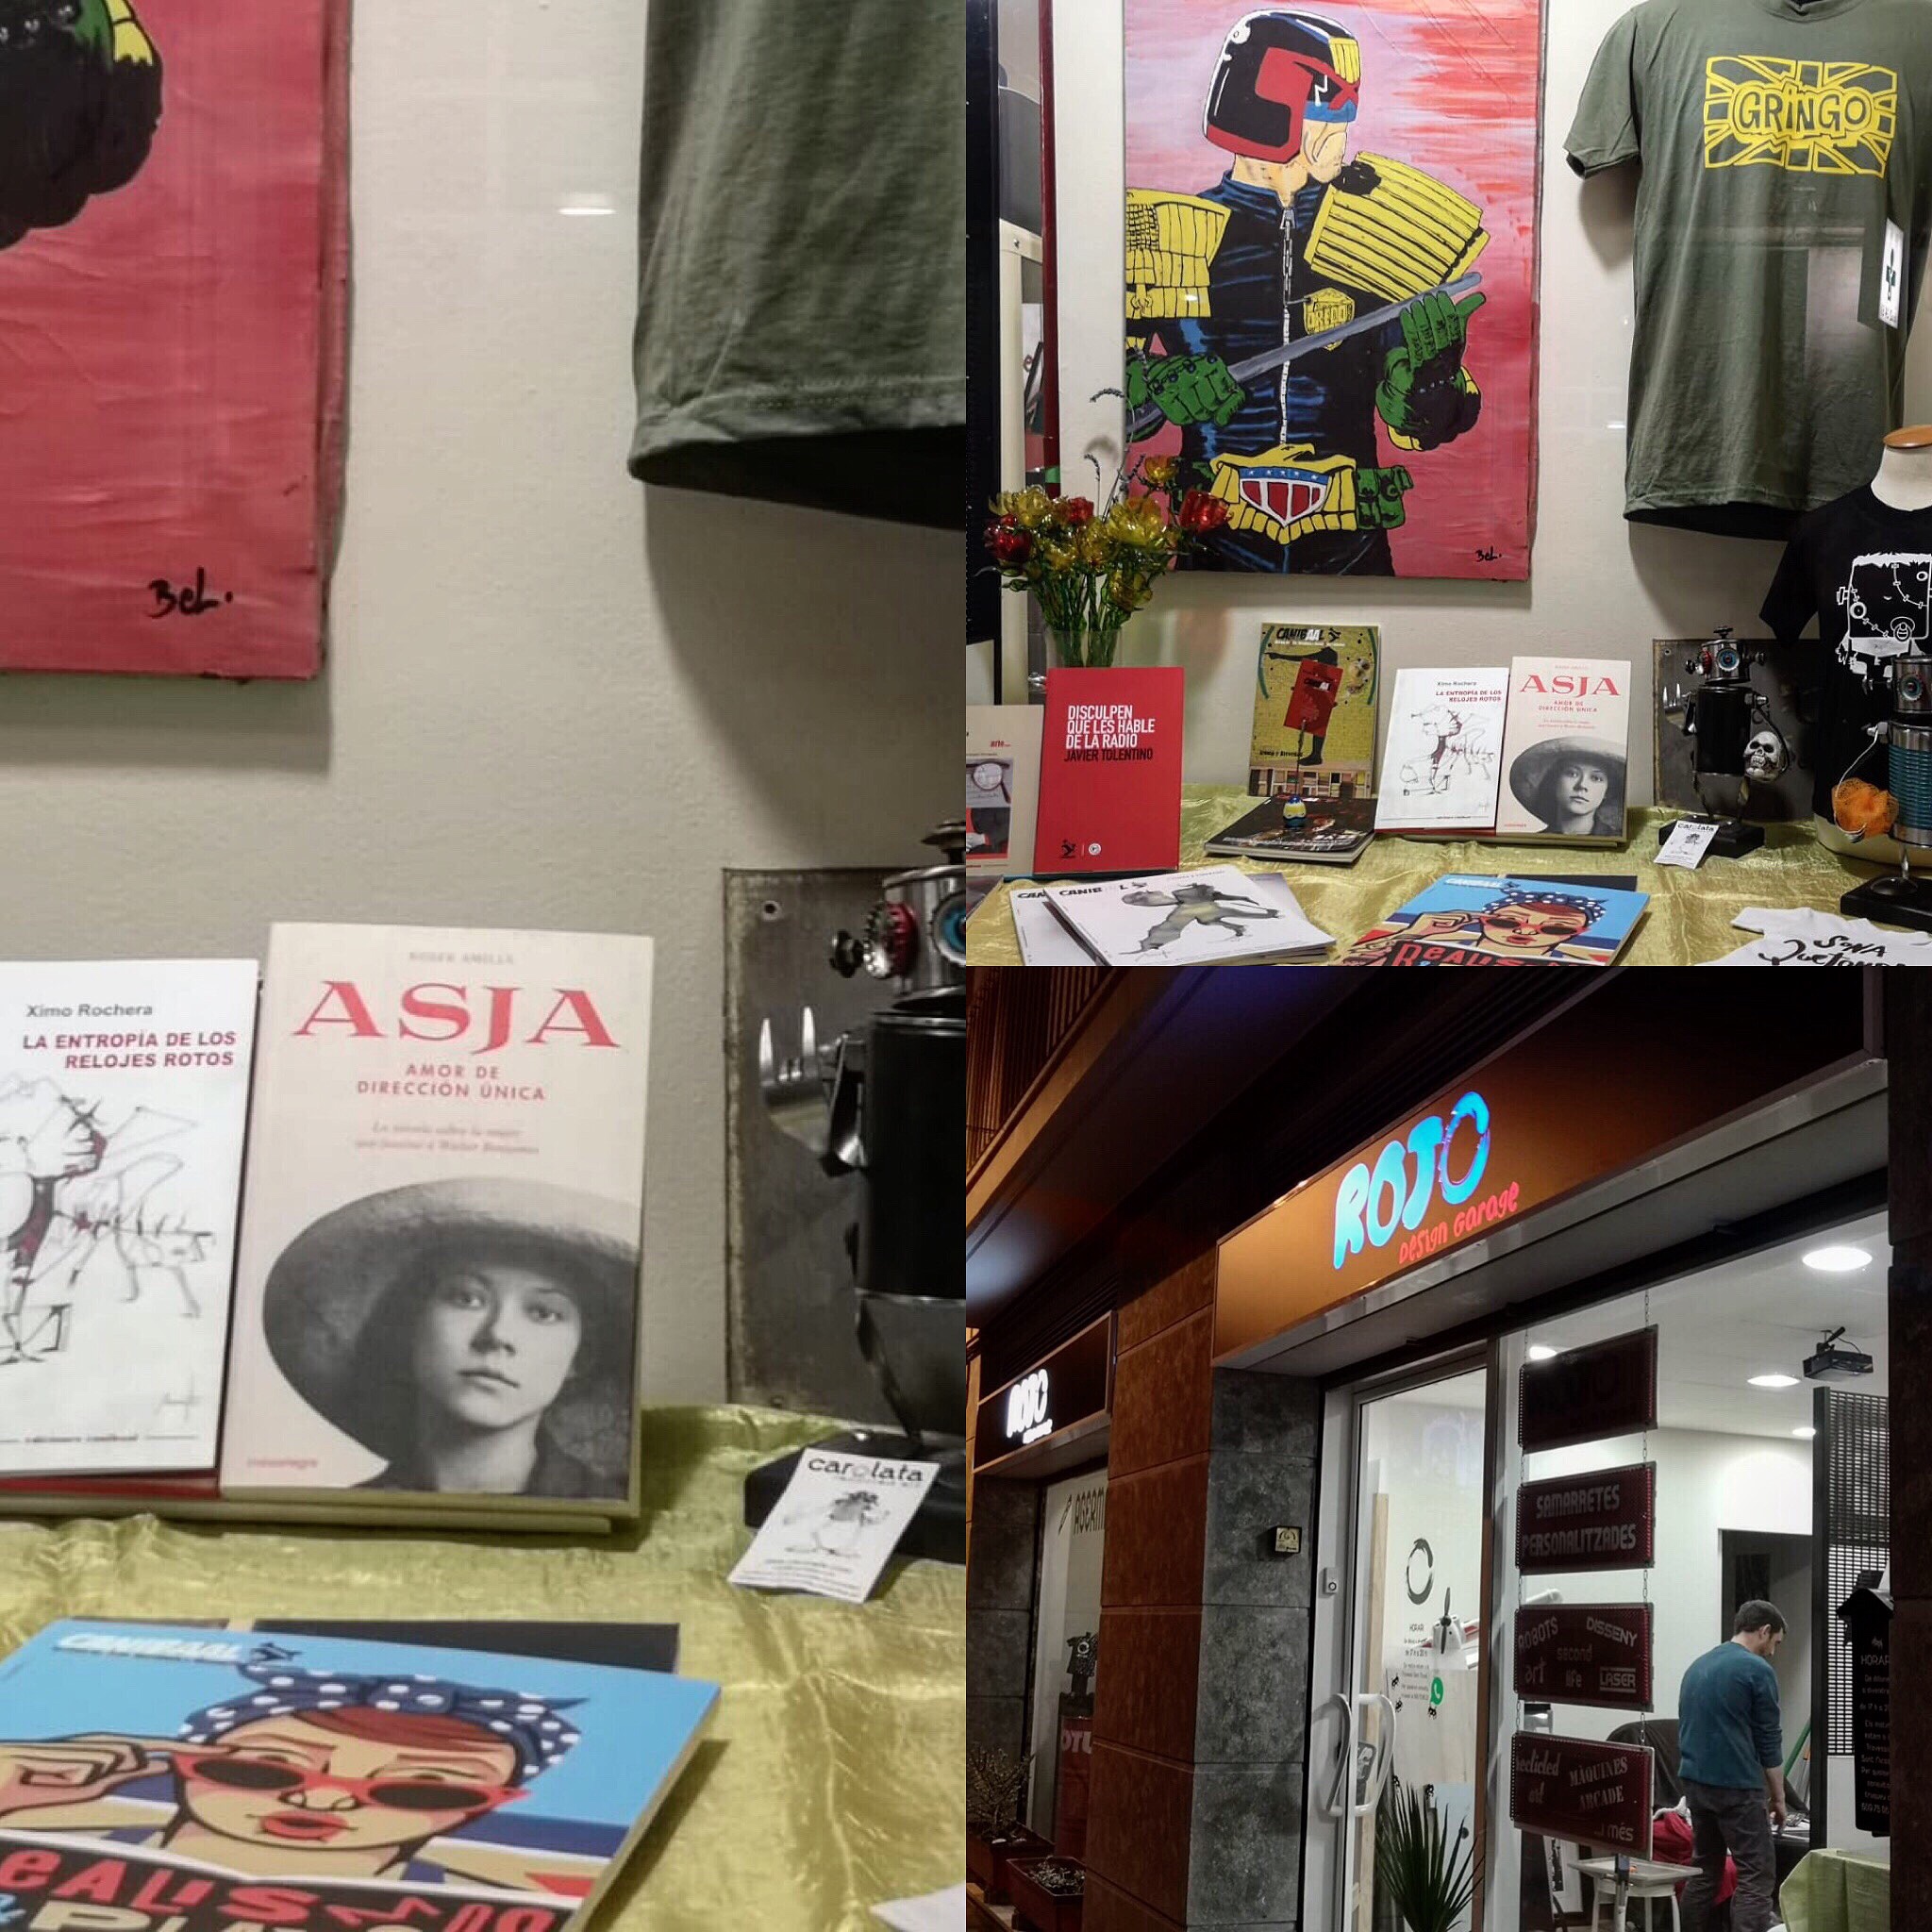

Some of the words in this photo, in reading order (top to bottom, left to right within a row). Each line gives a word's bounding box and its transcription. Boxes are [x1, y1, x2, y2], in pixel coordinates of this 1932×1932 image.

[1739, 89, 1868, 132] GRINGO
[1520, 675, 1620, 697] ASJA
[1068, 705, 1133, 720] DISCULPEN
[1067, 720, 1091, 734] QUE
[1093, 720, 1115, 734] LES
[1118, 719, 1156, 733] HABLE
[1066, 734, 1082, 749] DE
[1085, 734, 1099, 749] LA
[1102, 733, 1138, 748] RADIO
[1064, 749, 1099, 762] JAVIER
[1101, 747, 1153, 761] TOLENTINO
[26, 1004, 73, 1017] Ximo
[77, 1003, 153, 1017] Rochera
[291, 980, 621, 1056] ASJA
[23, 1035, 47, 1049] LA
[55, 1030, 158, 1049] ENTROPÍA
[166, 1032, 192, 1047] DE
[198, 1031, 236, 1046] LOS
[65, 1053, 157, 1069] RELOJES
[163, 1051, 235, 1067] ROTOS
[406, 1063, 464, 1078] AMOR
[476, 1065, 501, 1079] DE
[358, 1079, 470, 1097] DIRECCIÓN
[479, 1083, 545, 1101] ÚNICA
[1333, 1091, 1491, 1269] ROJO
[808, 1457, 924, 1482] carolata
[1536, 1484, 1620, 1519] SAMARRETES
[1523, 1524, 1637, 1557] PERSONALITZADES
[1586, 1616, 1638, 1648] DISSENY
